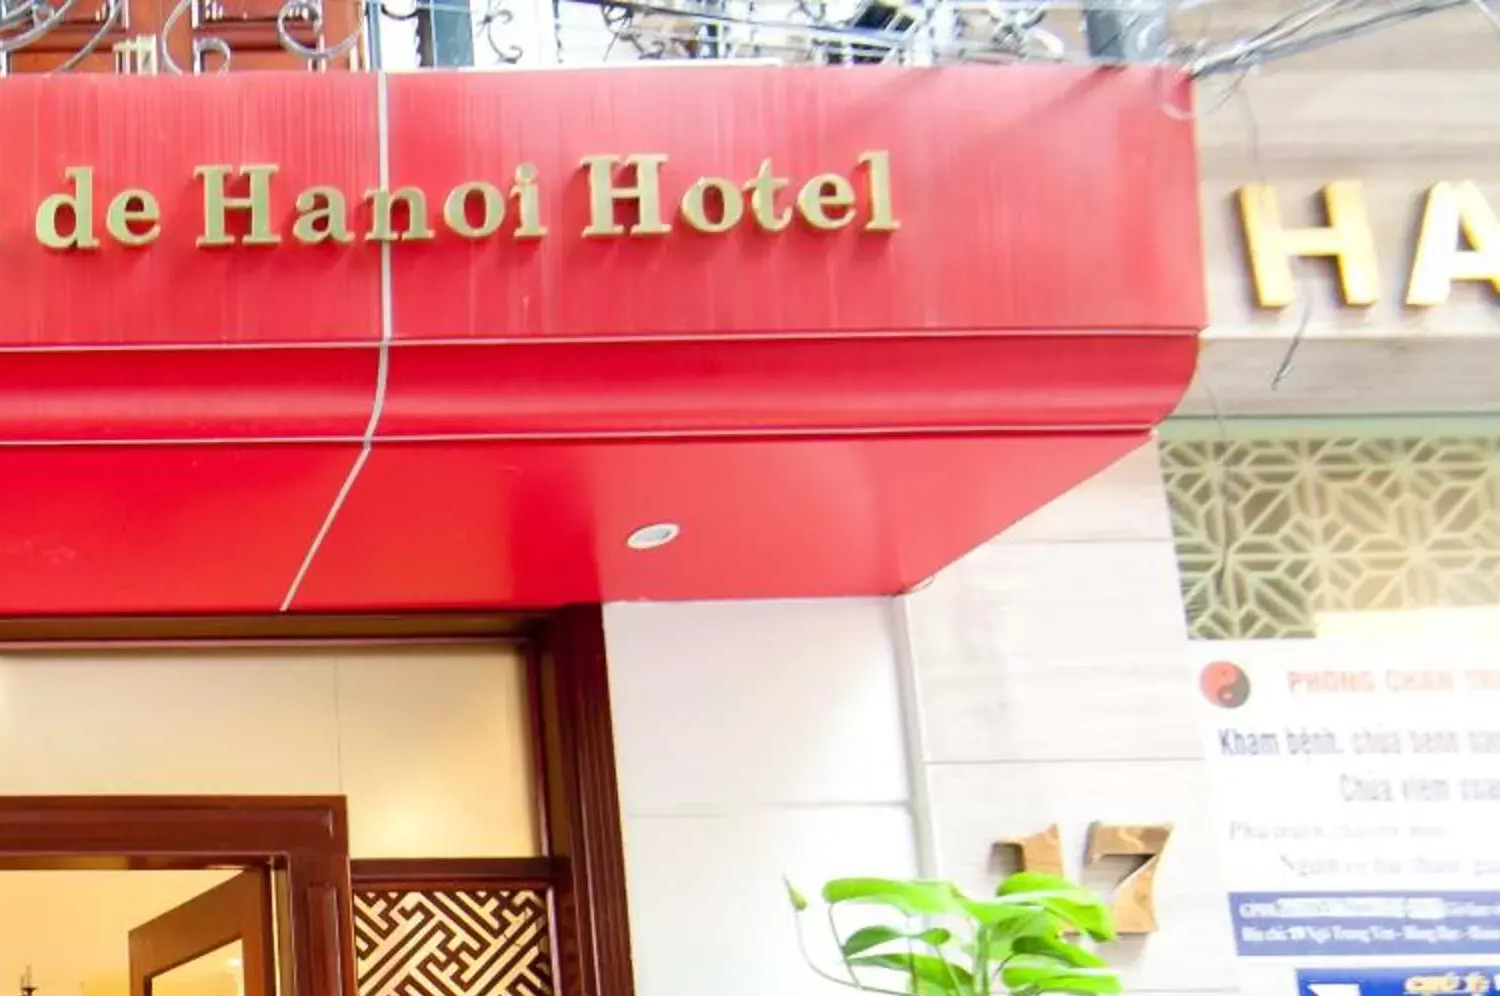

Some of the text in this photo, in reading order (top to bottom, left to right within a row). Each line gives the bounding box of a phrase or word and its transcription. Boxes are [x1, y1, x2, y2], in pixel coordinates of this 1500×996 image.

[34, 165, 161, 251] de
[194, 161, 548, 247] Hanoi
[581, 150, 900, 238] Hotel
[1234, 180, 1500, 307] HA
